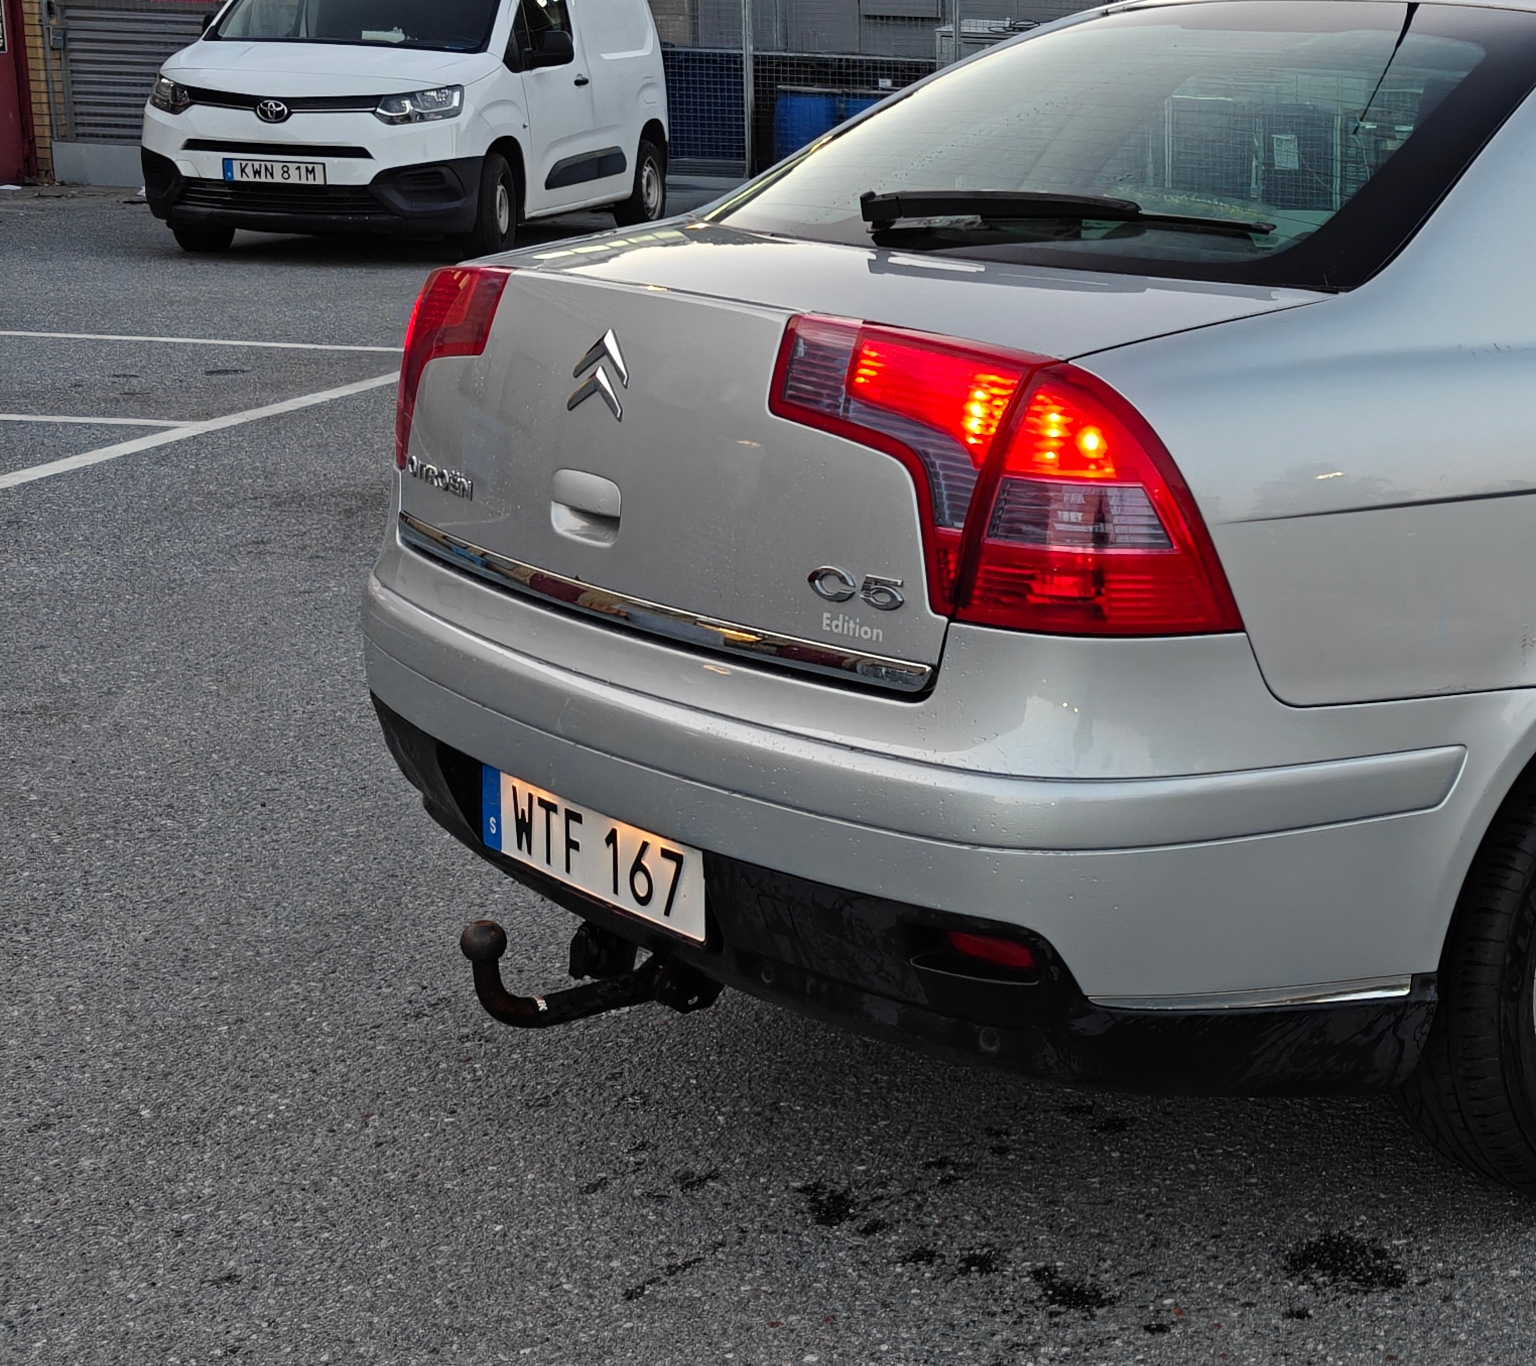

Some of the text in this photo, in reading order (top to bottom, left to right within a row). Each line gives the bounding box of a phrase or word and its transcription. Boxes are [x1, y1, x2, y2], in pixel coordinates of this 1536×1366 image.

[239, 162, 316, 182] KWN 81M
[807, 565, 905, 611] C5
[822, 612, 883, 643] Edition
[511, 784, 584, 875] WTF
[604, 827, 685, 918] 167
